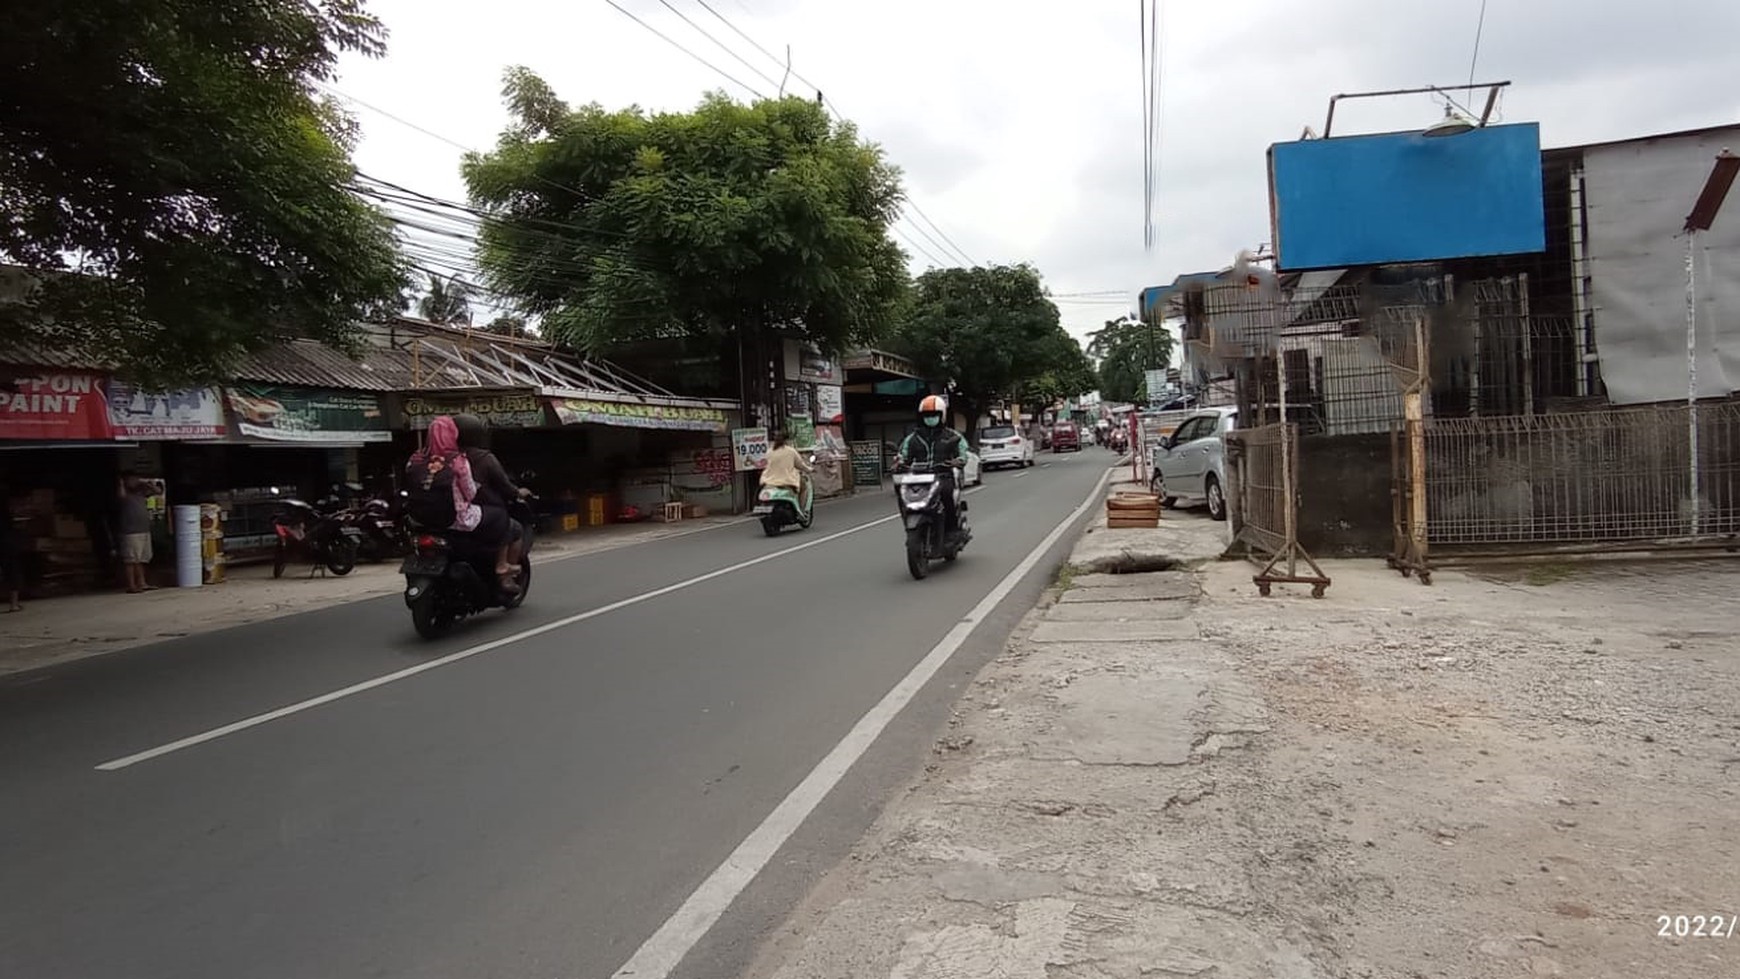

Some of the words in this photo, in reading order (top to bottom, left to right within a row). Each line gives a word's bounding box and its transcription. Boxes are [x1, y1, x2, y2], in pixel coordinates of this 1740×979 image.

[663, 406, 724, 422] BUAH
[143, 427, 162, 435] CAT
[164, 427, 193, 435] MAJU
[194, 427, 217, 435] JAYA
[736, 443, 767, 455] 19.000
